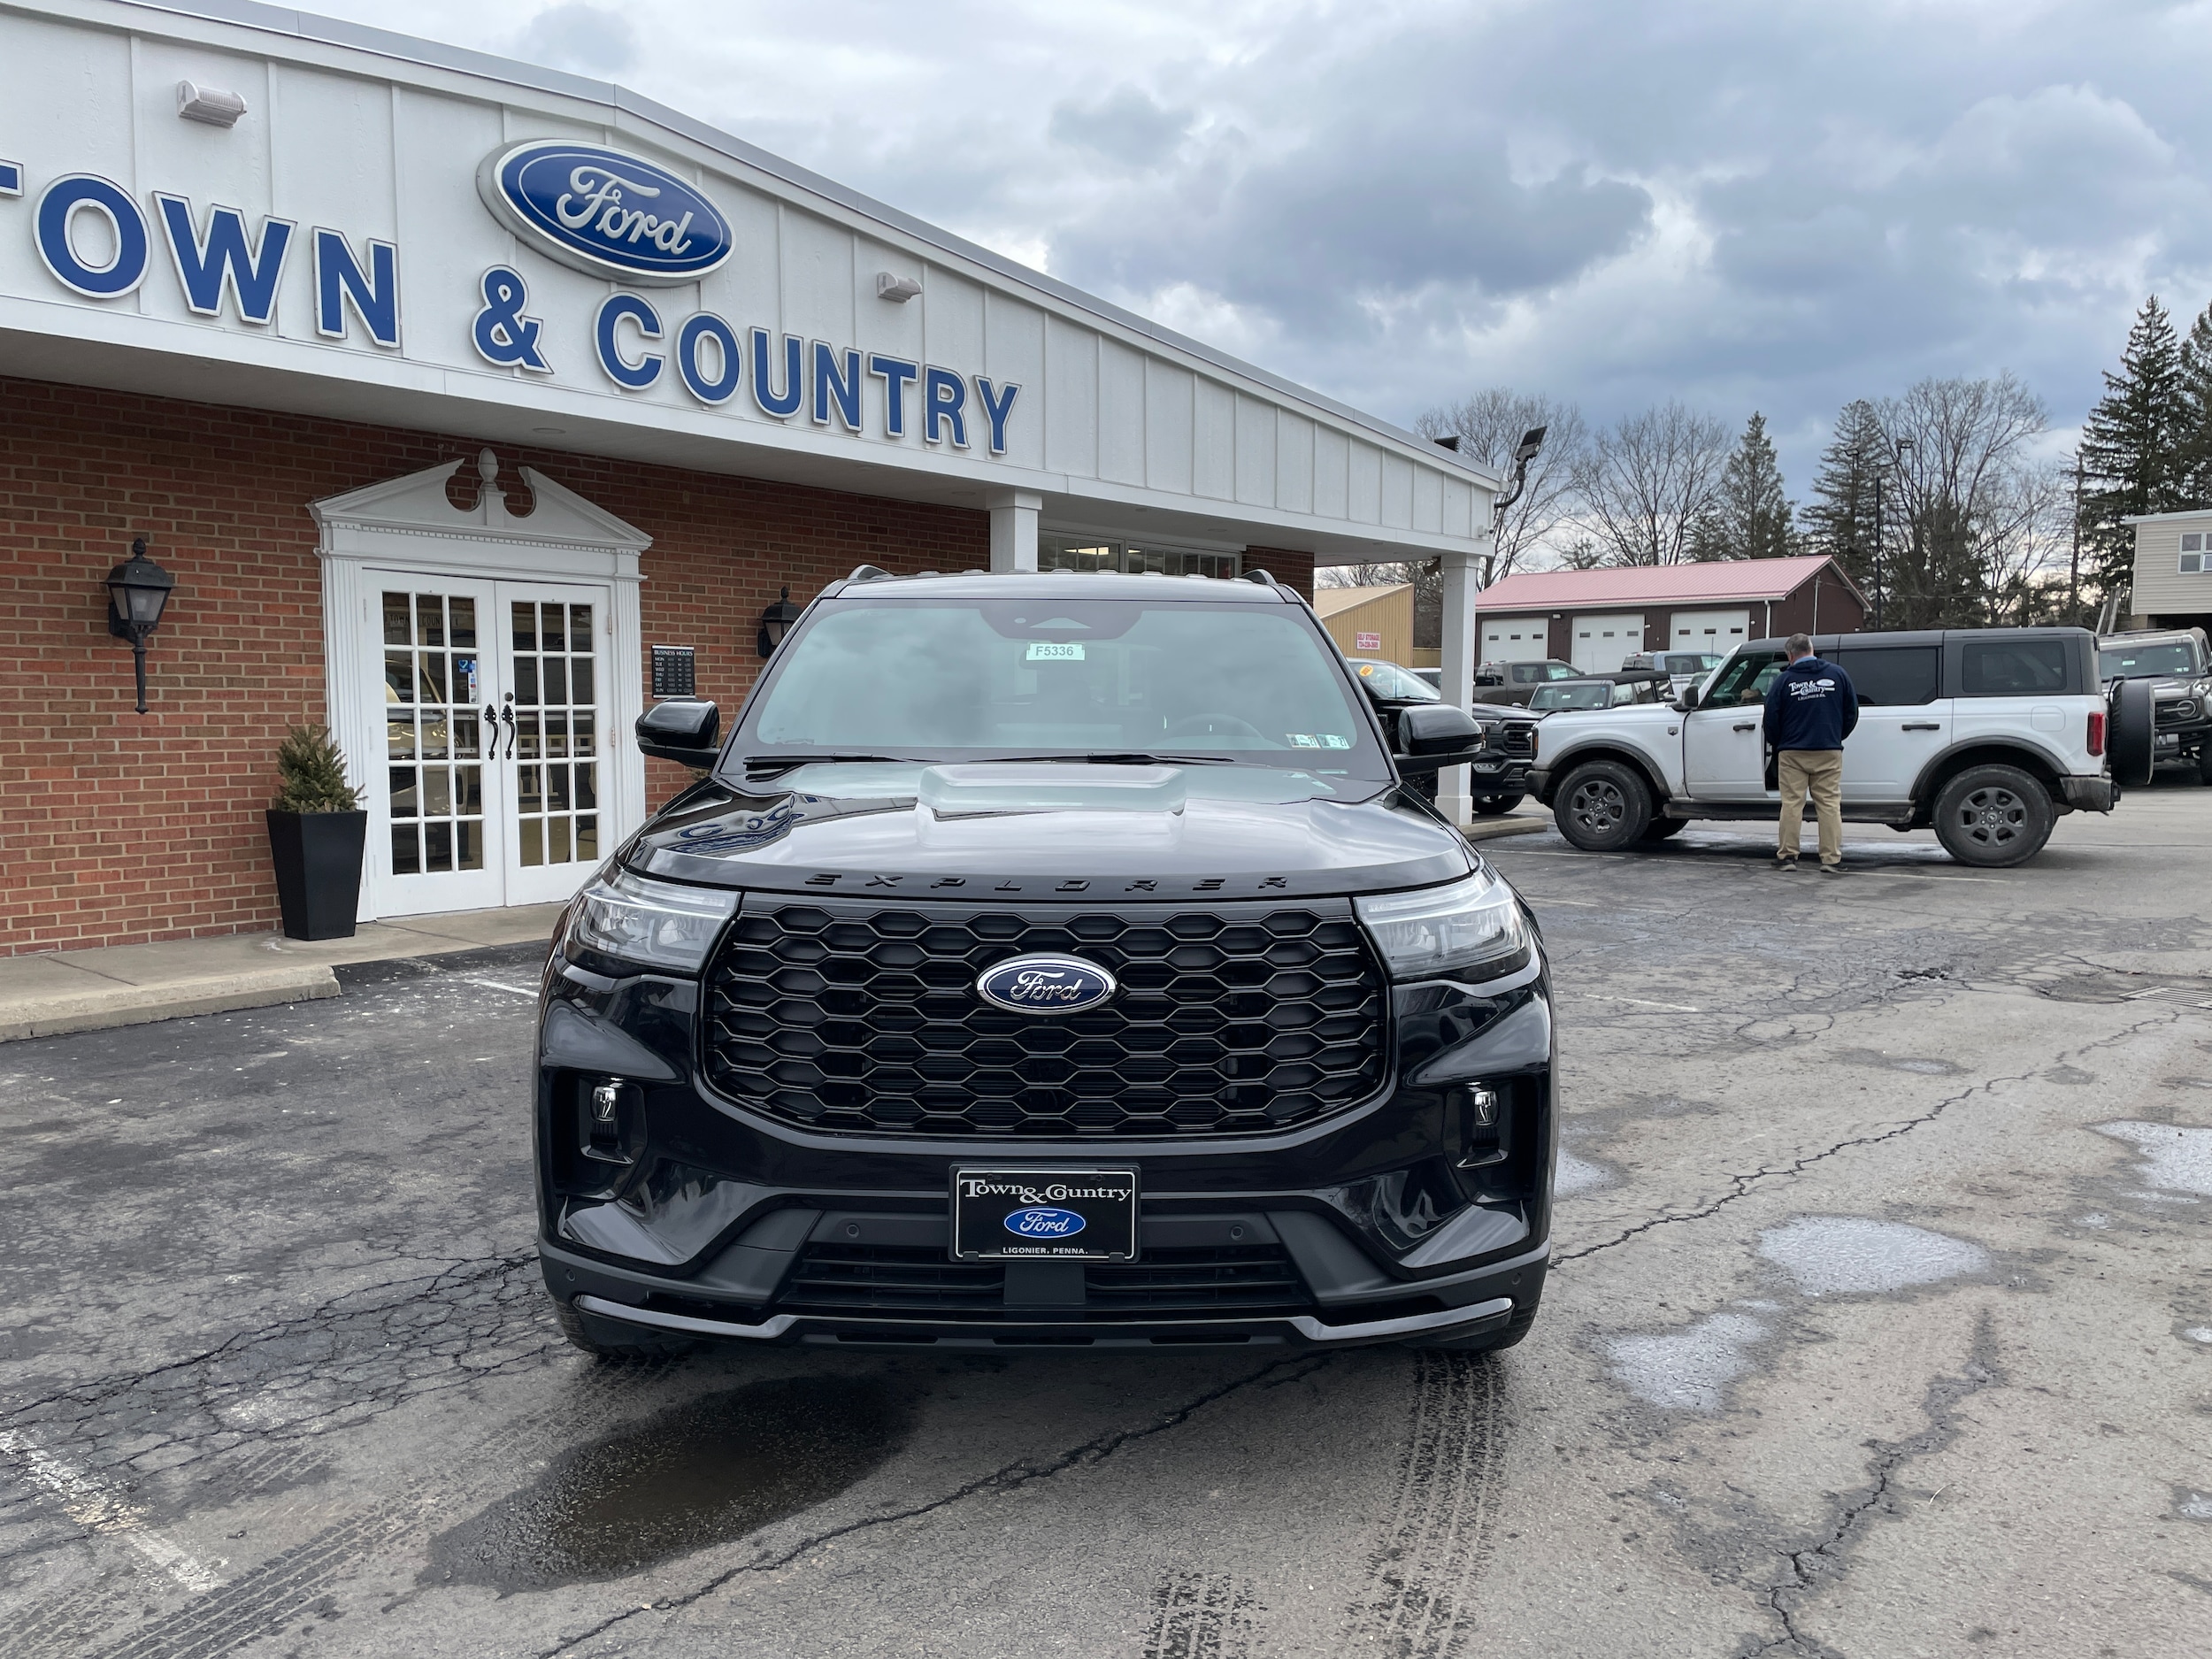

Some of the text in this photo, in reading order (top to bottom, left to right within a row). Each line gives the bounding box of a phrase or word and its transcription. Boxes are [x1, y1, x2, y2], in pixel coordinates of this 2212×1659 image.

[556, 165, 695, 256] Ford
[0, 159, 1022, 455] OWN & COUNTRY
[1035, 646, 1074, 657] F5336
[1788, 681, 1809, 692] Town
[804, 872, 1289, 893] EXPLORER
[1010, 970, 1083, 1001] Ford
[1019, 1210, 1071, 1233] Ford
